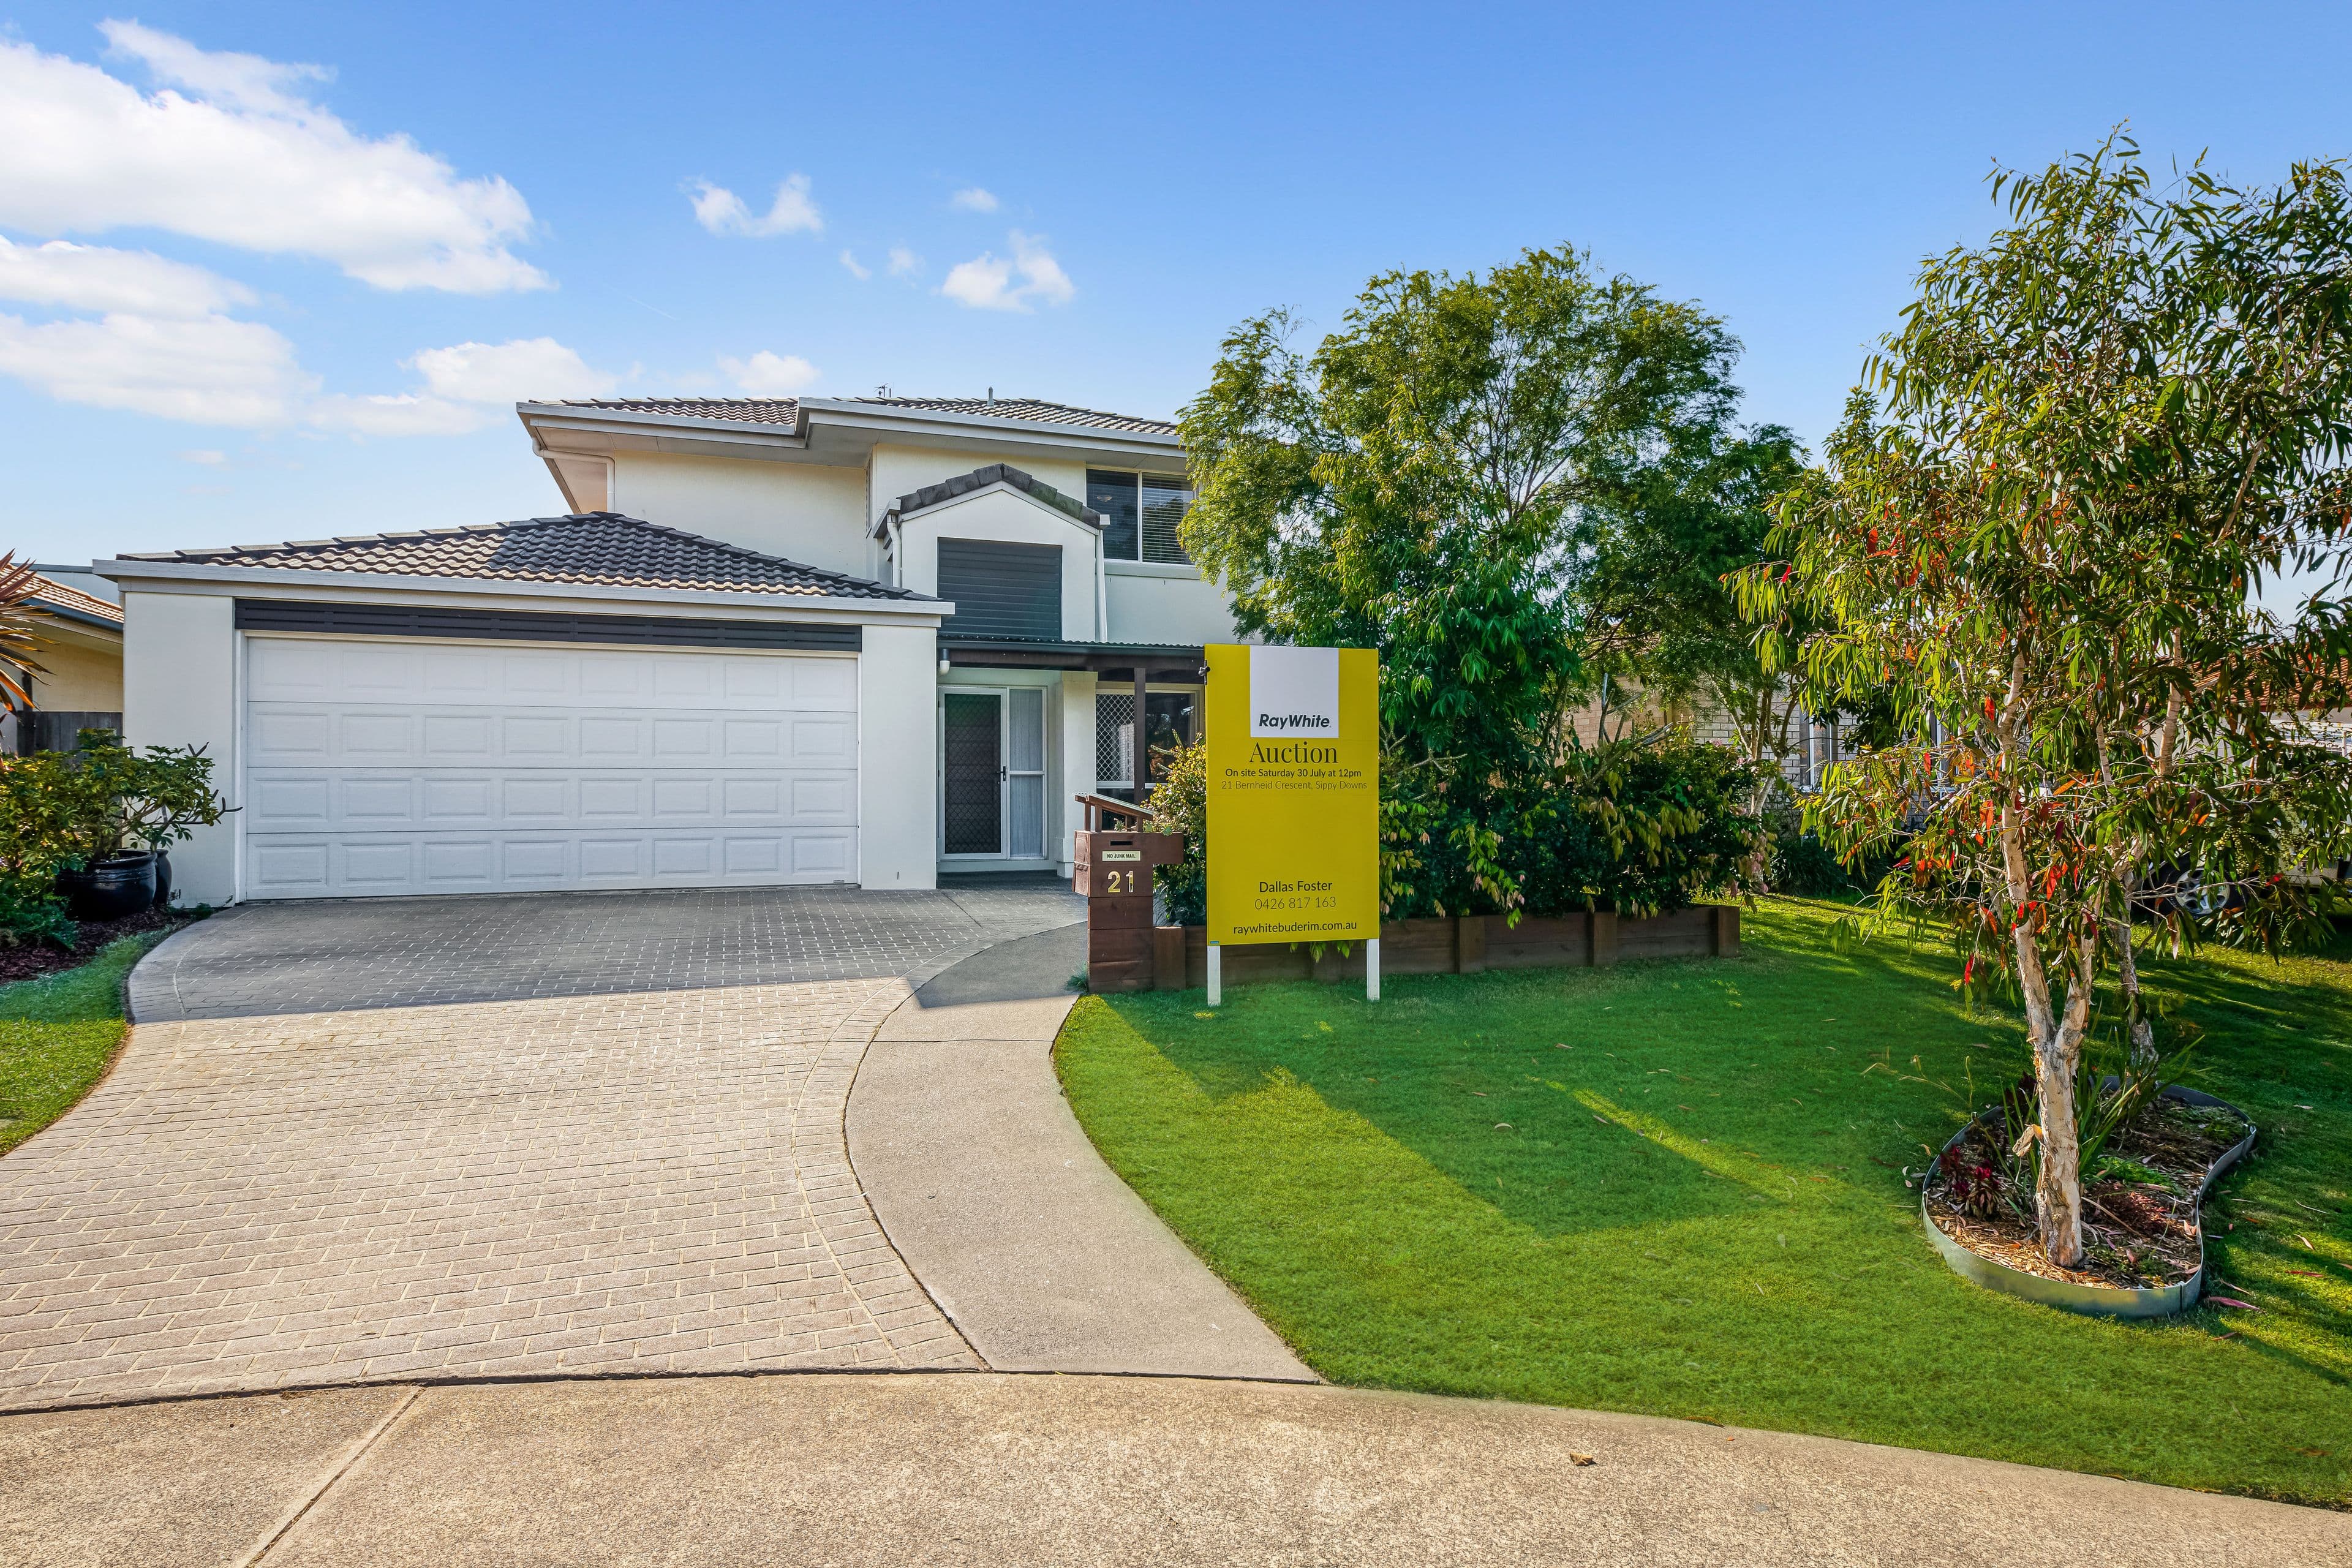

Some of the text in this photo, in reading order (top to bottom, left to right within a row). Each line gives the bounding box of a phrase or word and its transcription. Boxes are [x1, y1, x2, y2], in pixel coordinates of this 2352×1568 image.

[1249, 741, 1338, 763] Auction
[1258, 769, 1295, 778] Saturday
[1310, 769, 1325, 778] July
[1338, 769, 1361, 778] 12pm
[1315, 782, 1336, 790] Sippy
[1107, 871, 1133, 893] 21
[1259, 880, 1333, 892] Dallas Foster
[1254, 897, 1336, 910] 0426 817 163
[1233, 921, 1357, 935] raywhitebuderim.com.au
